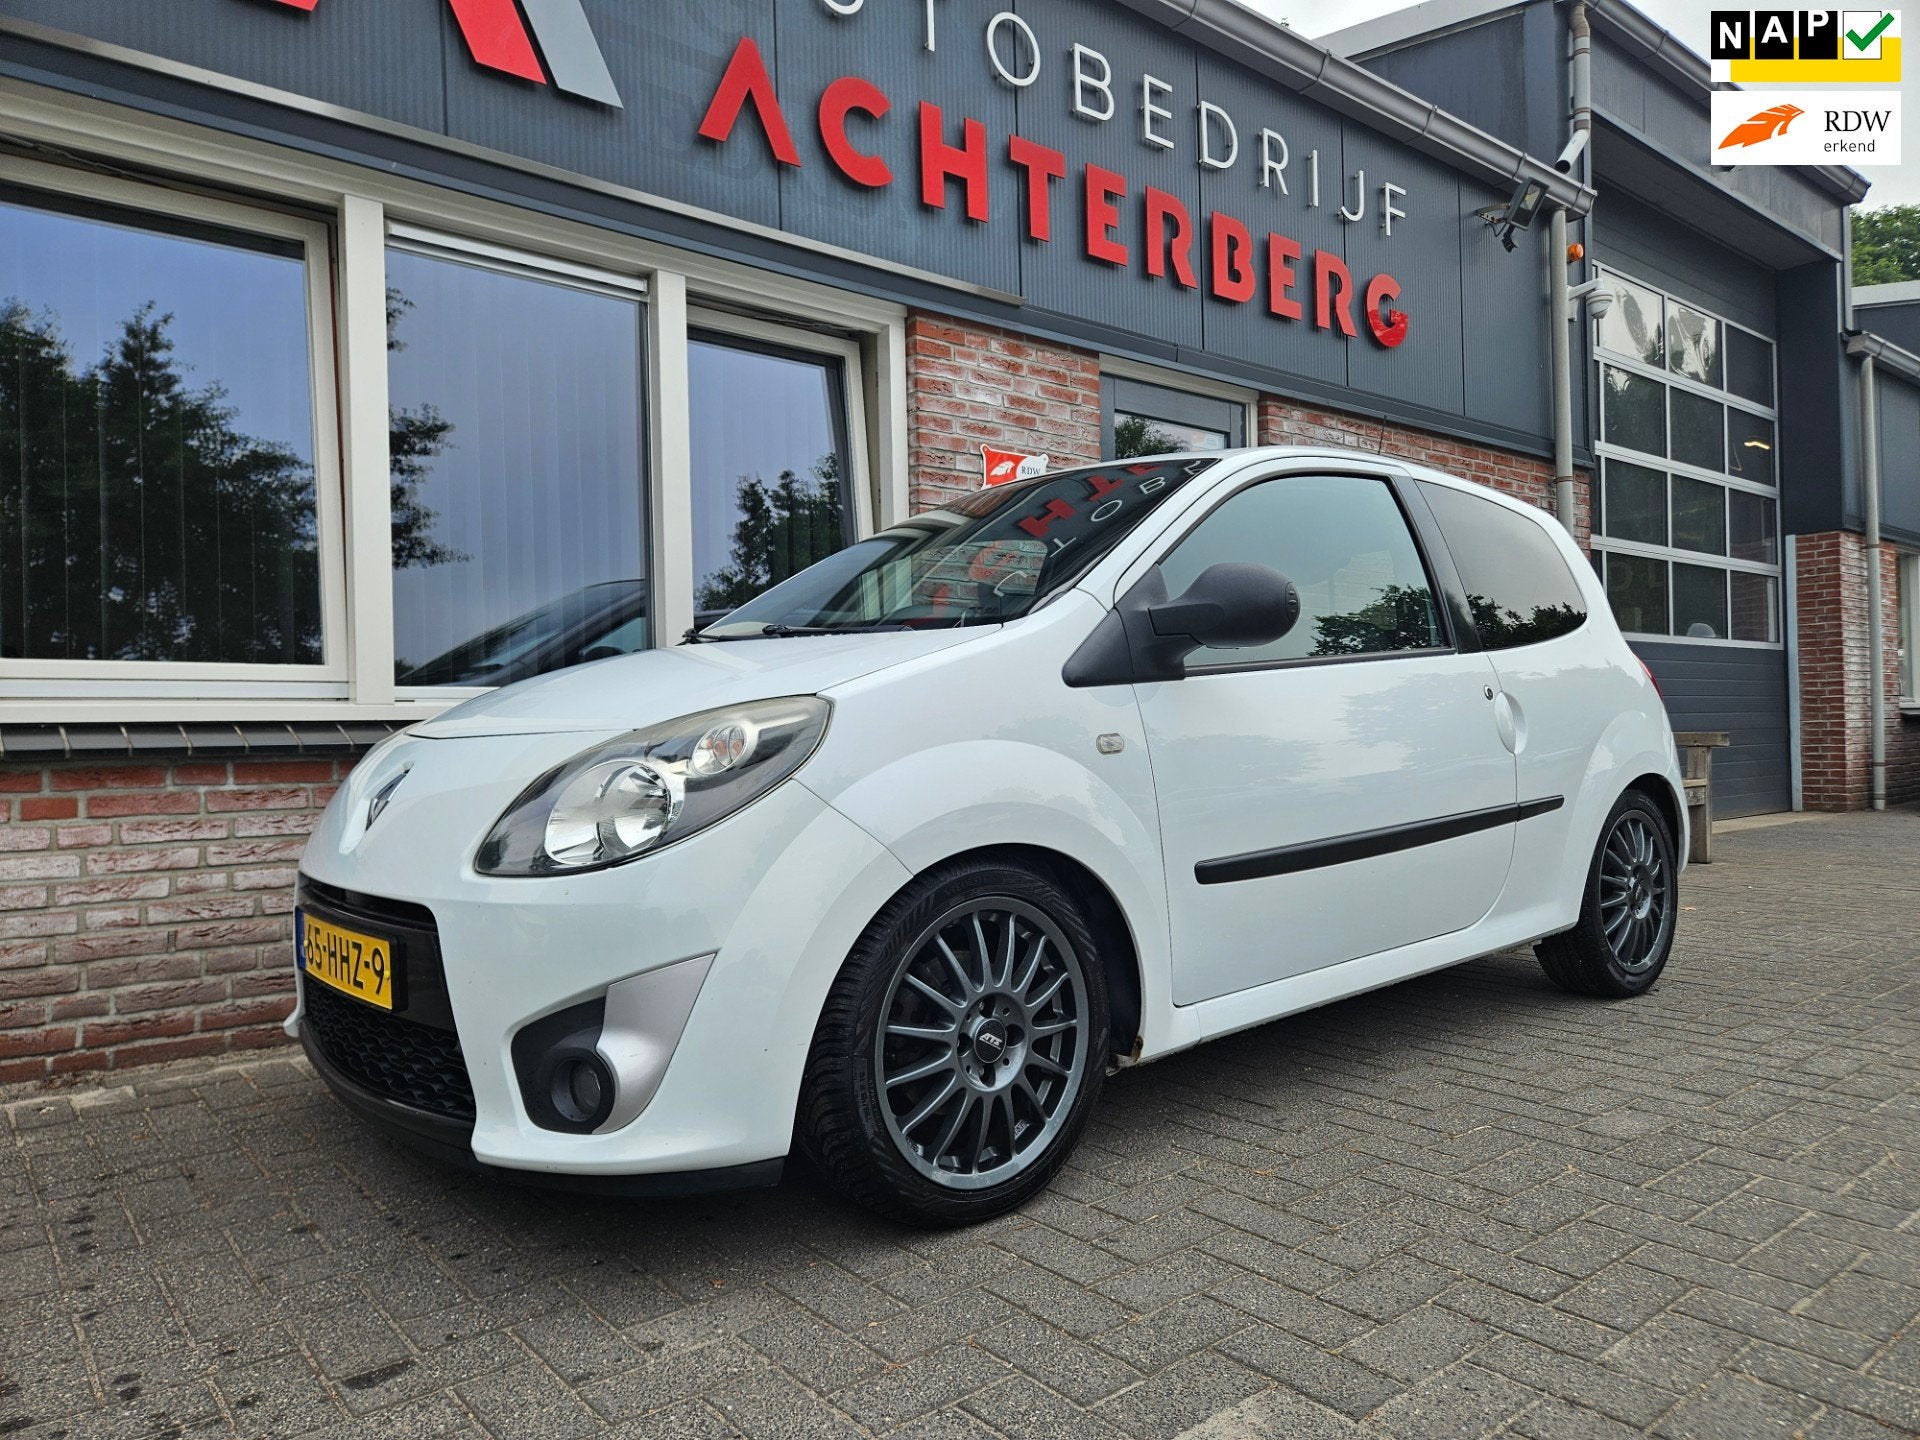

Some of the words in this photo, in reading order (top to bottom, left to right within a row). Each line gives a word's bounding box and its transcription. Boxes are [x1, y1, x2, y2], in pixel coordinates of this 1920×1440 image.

[698, 35, 1409, 348] ACHTERBERG
[1021, 466, 1041, 476] RDW
[307, 923, 385, 995] 65-HHZ-9
